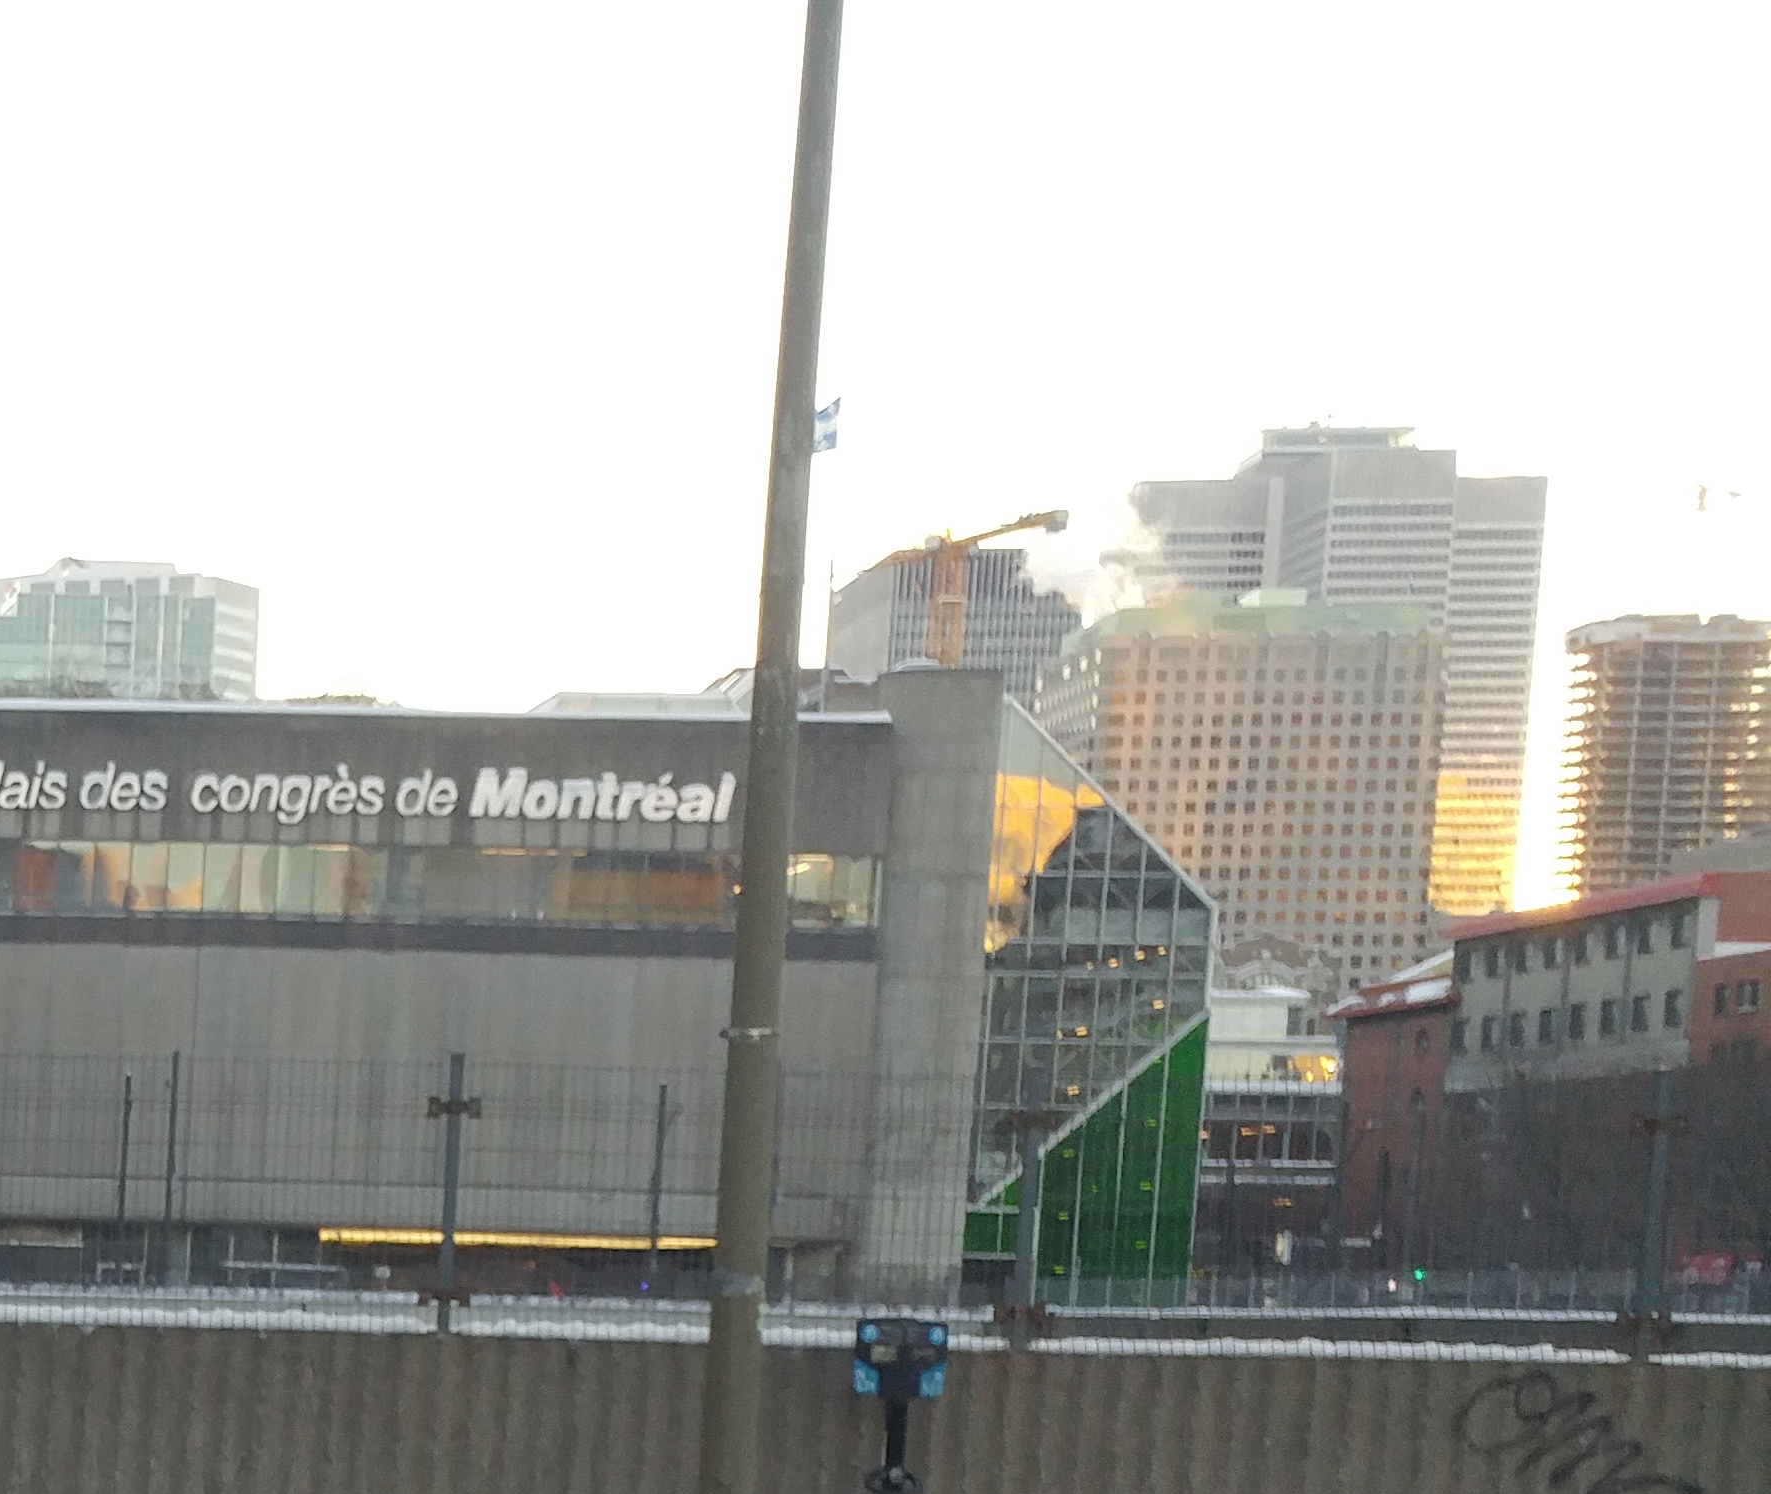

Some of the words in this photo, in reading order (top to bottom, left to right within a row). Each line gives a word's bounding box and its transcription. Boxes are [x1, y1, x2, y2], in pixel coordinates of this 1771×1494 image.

[80, 760, 169, 812] des
[191, 762, 386, 825] congrès
[396, 767, 458, 817] de
[468, 766, 737, 823] Montréal
